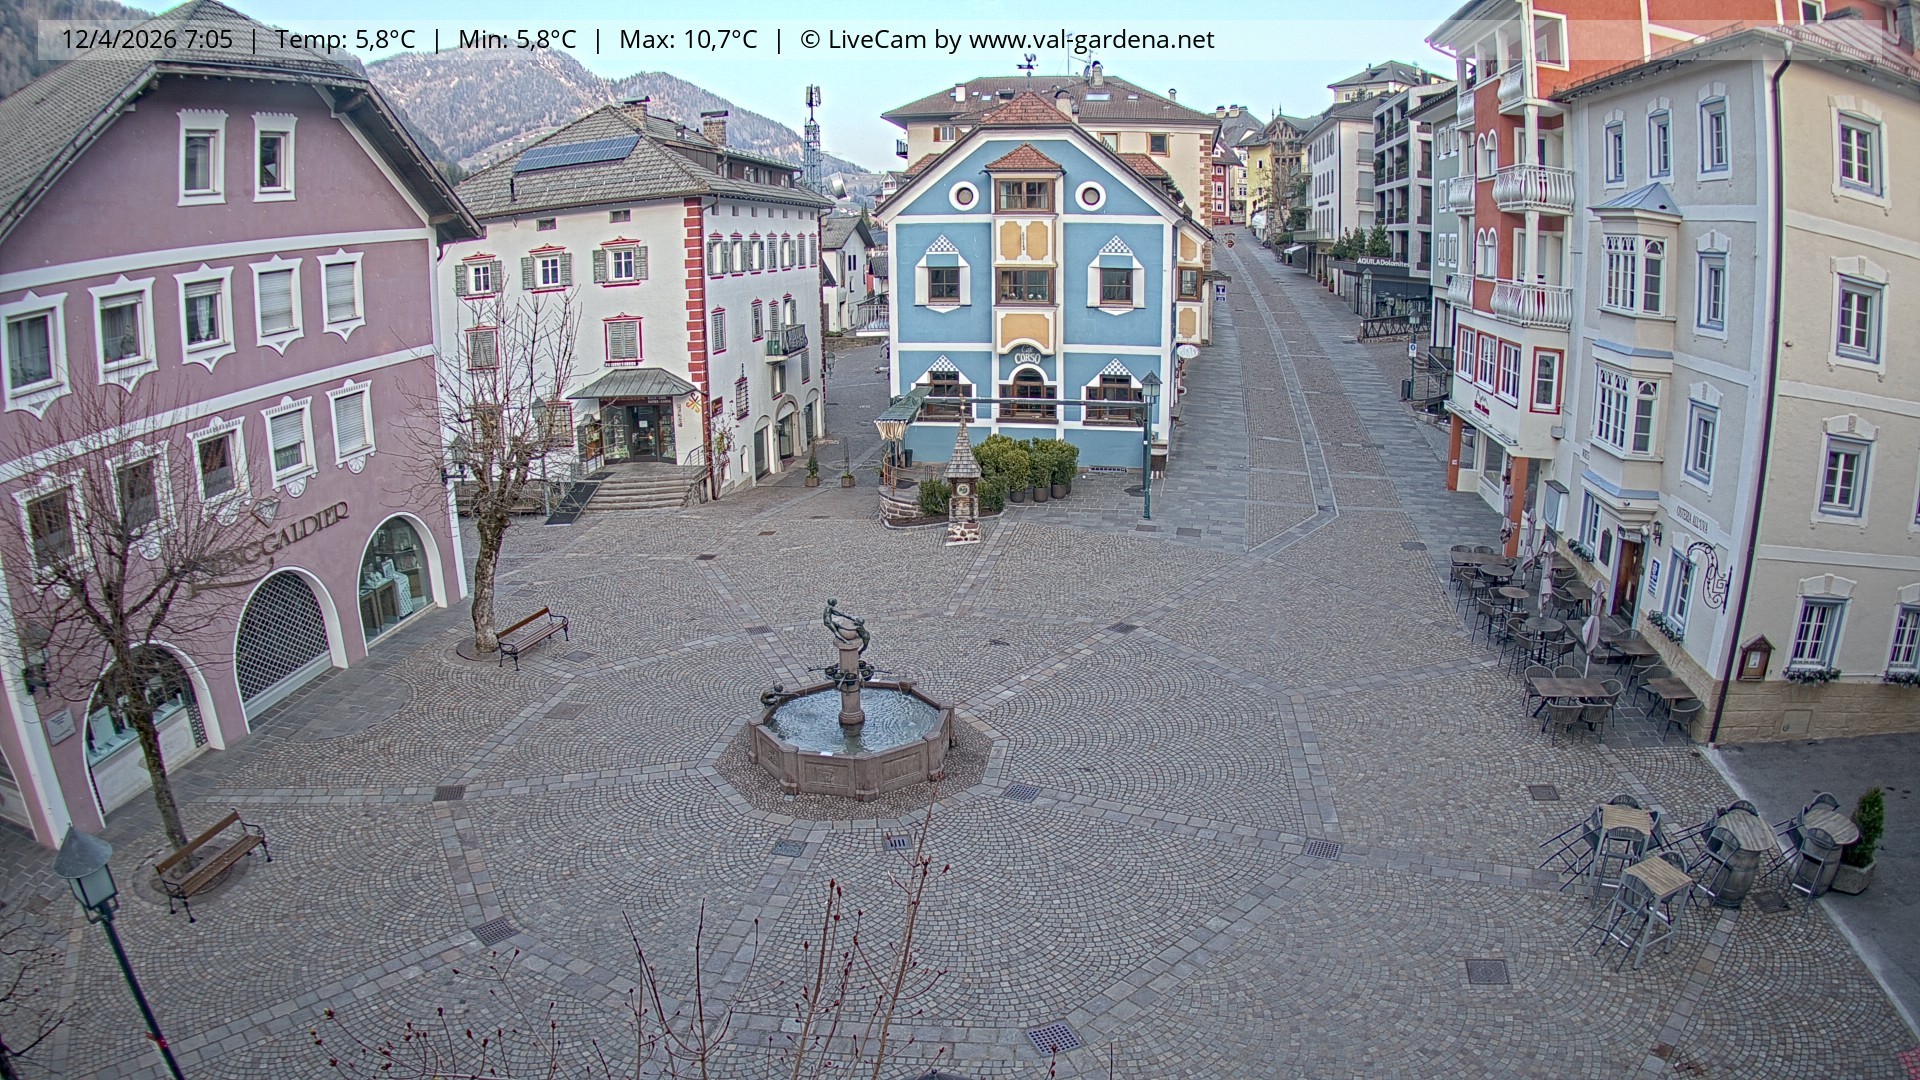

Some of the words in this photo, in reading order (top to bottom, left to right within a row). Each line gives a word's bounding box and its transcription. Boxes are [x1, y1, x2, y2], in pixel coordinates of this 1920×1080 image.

[1357, 257, 1380, 265] AQUILA
[1380, 258, 1409, 268] Dolomites
[1014, 353, 1041, 365] CORSO
